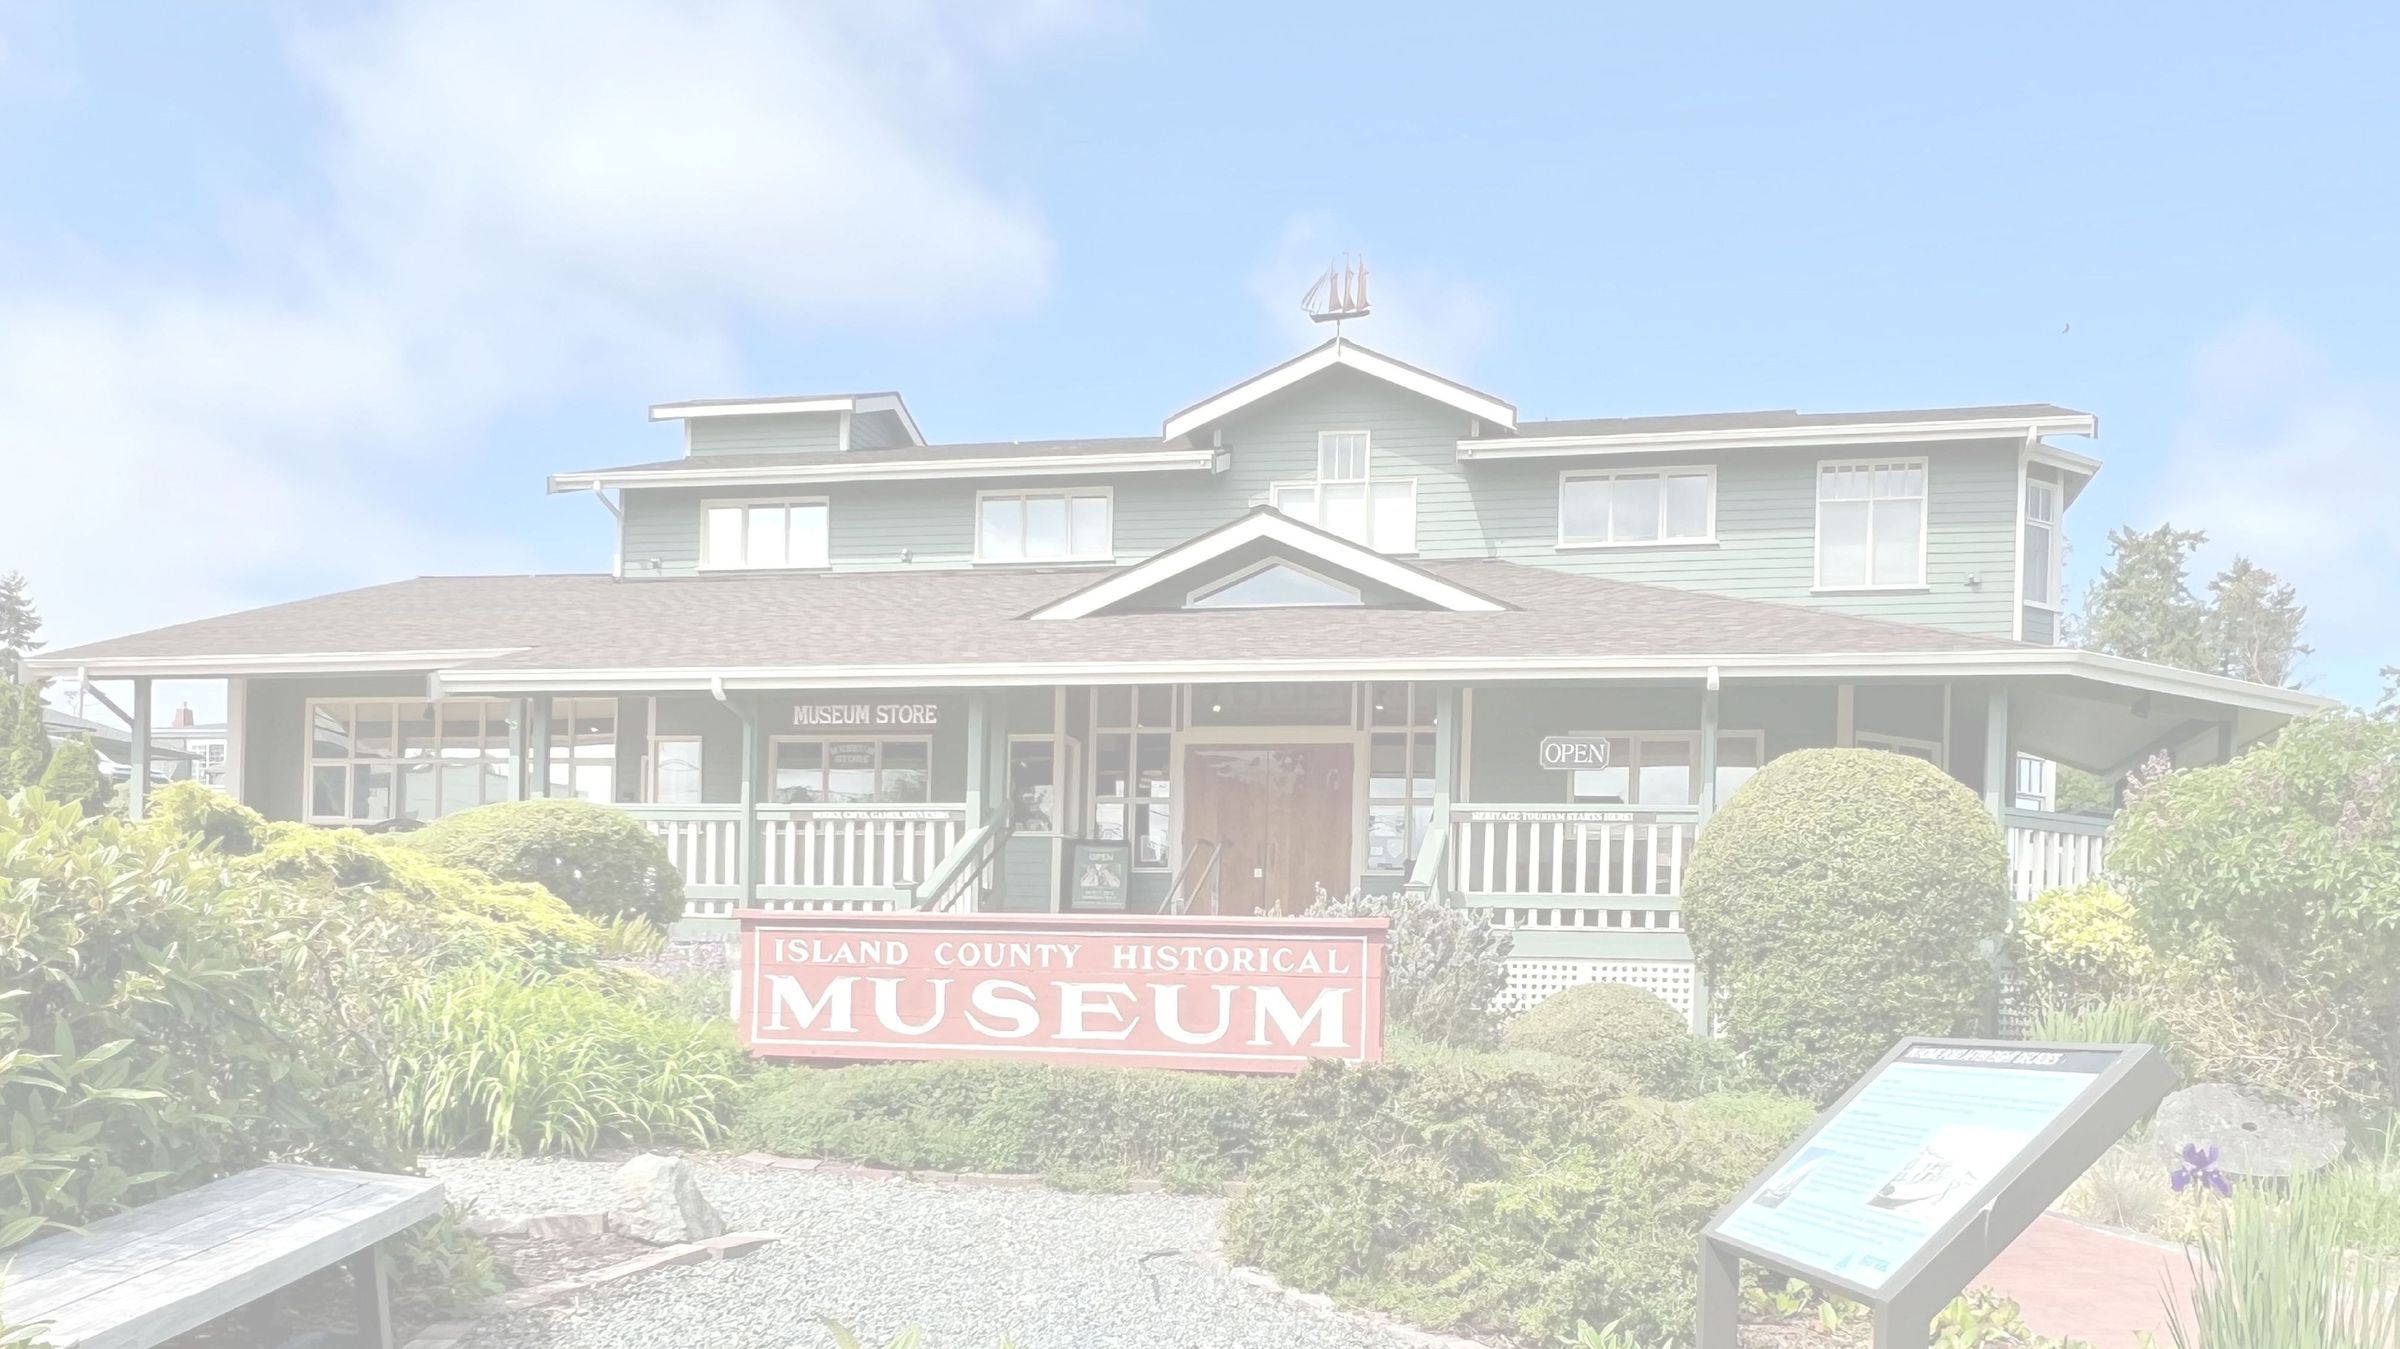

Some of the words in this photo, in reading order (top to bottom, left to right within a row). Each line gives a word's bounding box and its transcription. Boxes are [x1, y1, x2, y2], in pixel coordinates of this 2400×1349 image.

[792, 704, 869, 725] MUSEUM
[876, 704, 938, 724] STORE
[1544, 743, 1604, 764] OPEN
[774, 938, 910, 968] ISLAND
[934, 941, 1082, 970] COUNTY
[1112, 944, 1351, 975] HISTORICAL
[763, 974, 1353, 1049] MUSEUM
